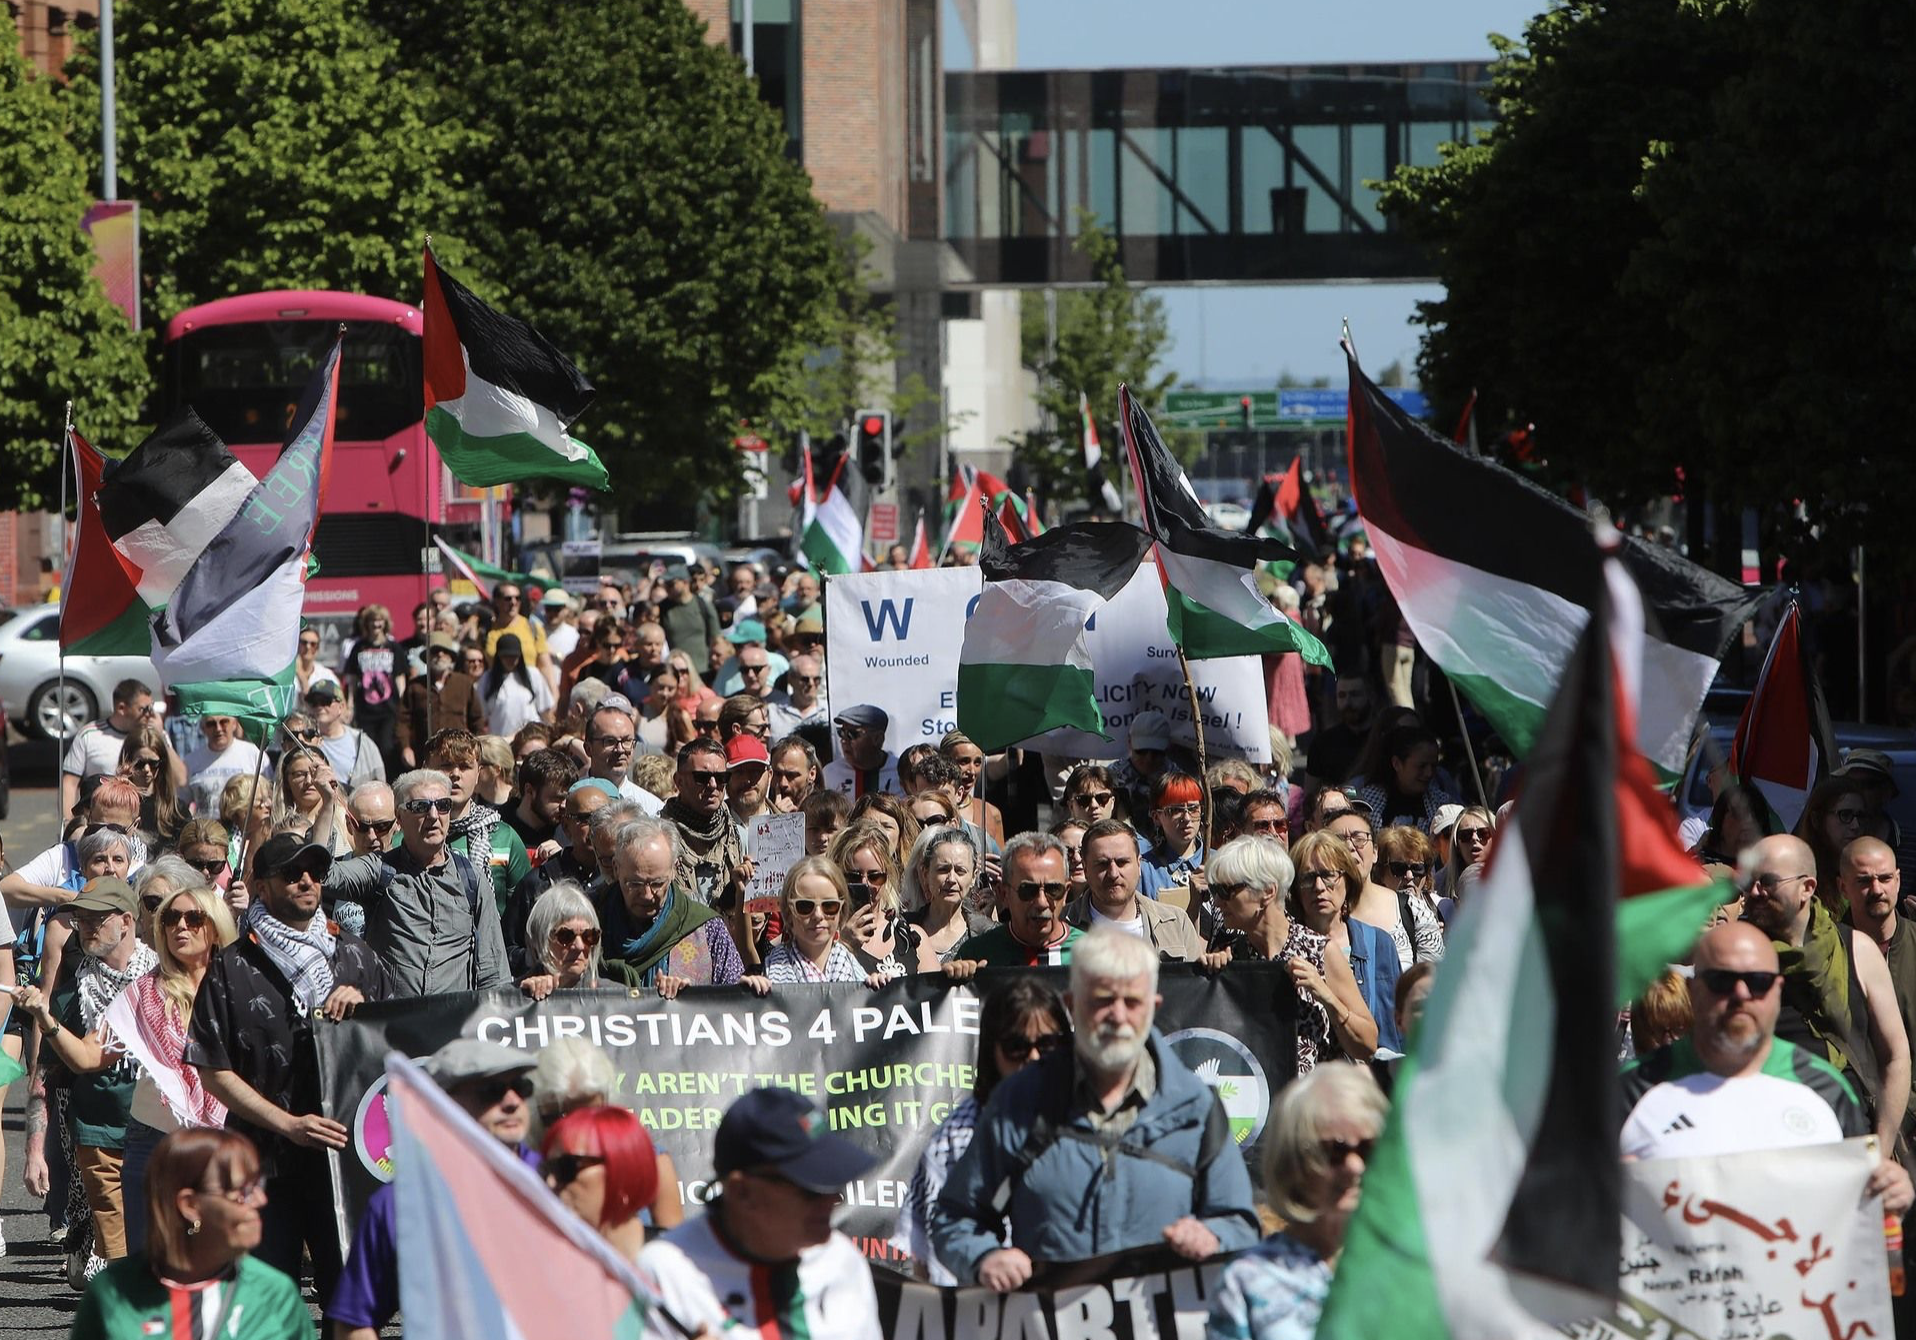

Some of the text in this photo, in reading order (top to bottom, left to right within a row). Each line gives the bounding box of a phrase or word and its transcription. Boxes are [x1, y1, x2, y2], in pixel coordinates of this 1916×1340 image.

[865, 654, 929, 669] Wounded
[477, 1010, 792, 1049] CHRISTIANS
[808, 1008, 836, 1045] 4
[824, 1062, 979, 1095] CHURCHE
[894, 1101, 922, 1127] IT
[1690, 1266, 1743, 1285] Rafah
